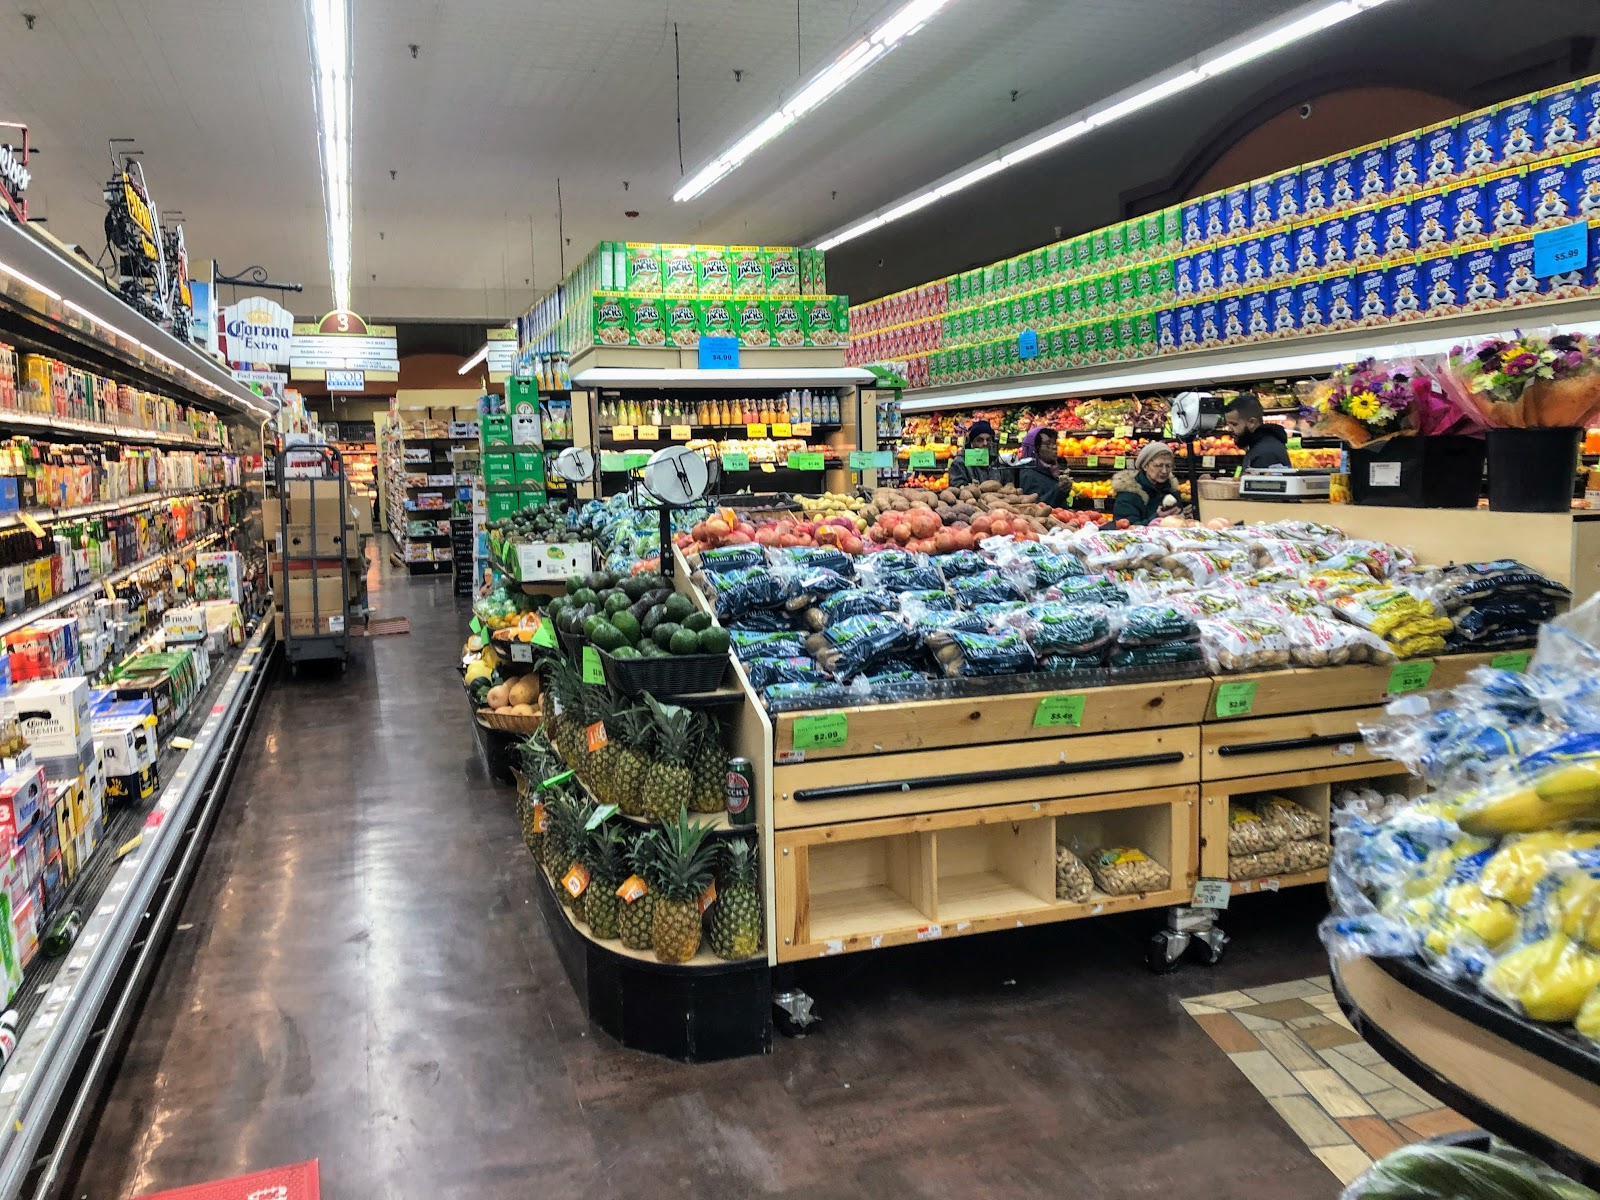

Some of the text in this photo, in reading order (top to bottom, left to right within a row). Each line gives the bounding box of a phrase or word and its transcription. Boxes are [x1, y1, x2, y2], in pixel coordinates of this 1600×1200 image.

[1531, 161, 1549, 170] GIANT
[1488, 171, 1505, 179] GIANT
[1554, 248, 1579, 262] $5.99
[632, 263, 658, 277] JACKS
[668, 263, 693, 278] JACKS
[703, 264, 728, 279] JACKS
[738, 264, 762, 279] JACKS
[771, 265, 795, 279] JACKS
[337, 314, 349, 332] 3
[598, 309, 623, 324] JACKS
[635, 310, 659, 325] JACKS
[670, 311, 695, 326] JACKS
[706, 312, 729, 327] JACKS
[741, 312, 763, 327] JACKS
[775, 312, 798, 327] JACKS
[809, 312, 832, 327] JACKS
[227, 320, 289, 340] Corona
[245, 337, 278, 351] Extra
[706, 556, 730, 564] IDAHO
[171, 615, 193, 623] TRULY
[737, 642, 762, 655] IDAHO
[25, 726, 64, 736] PREMIER
[27, 719, 59, 729] Corona
